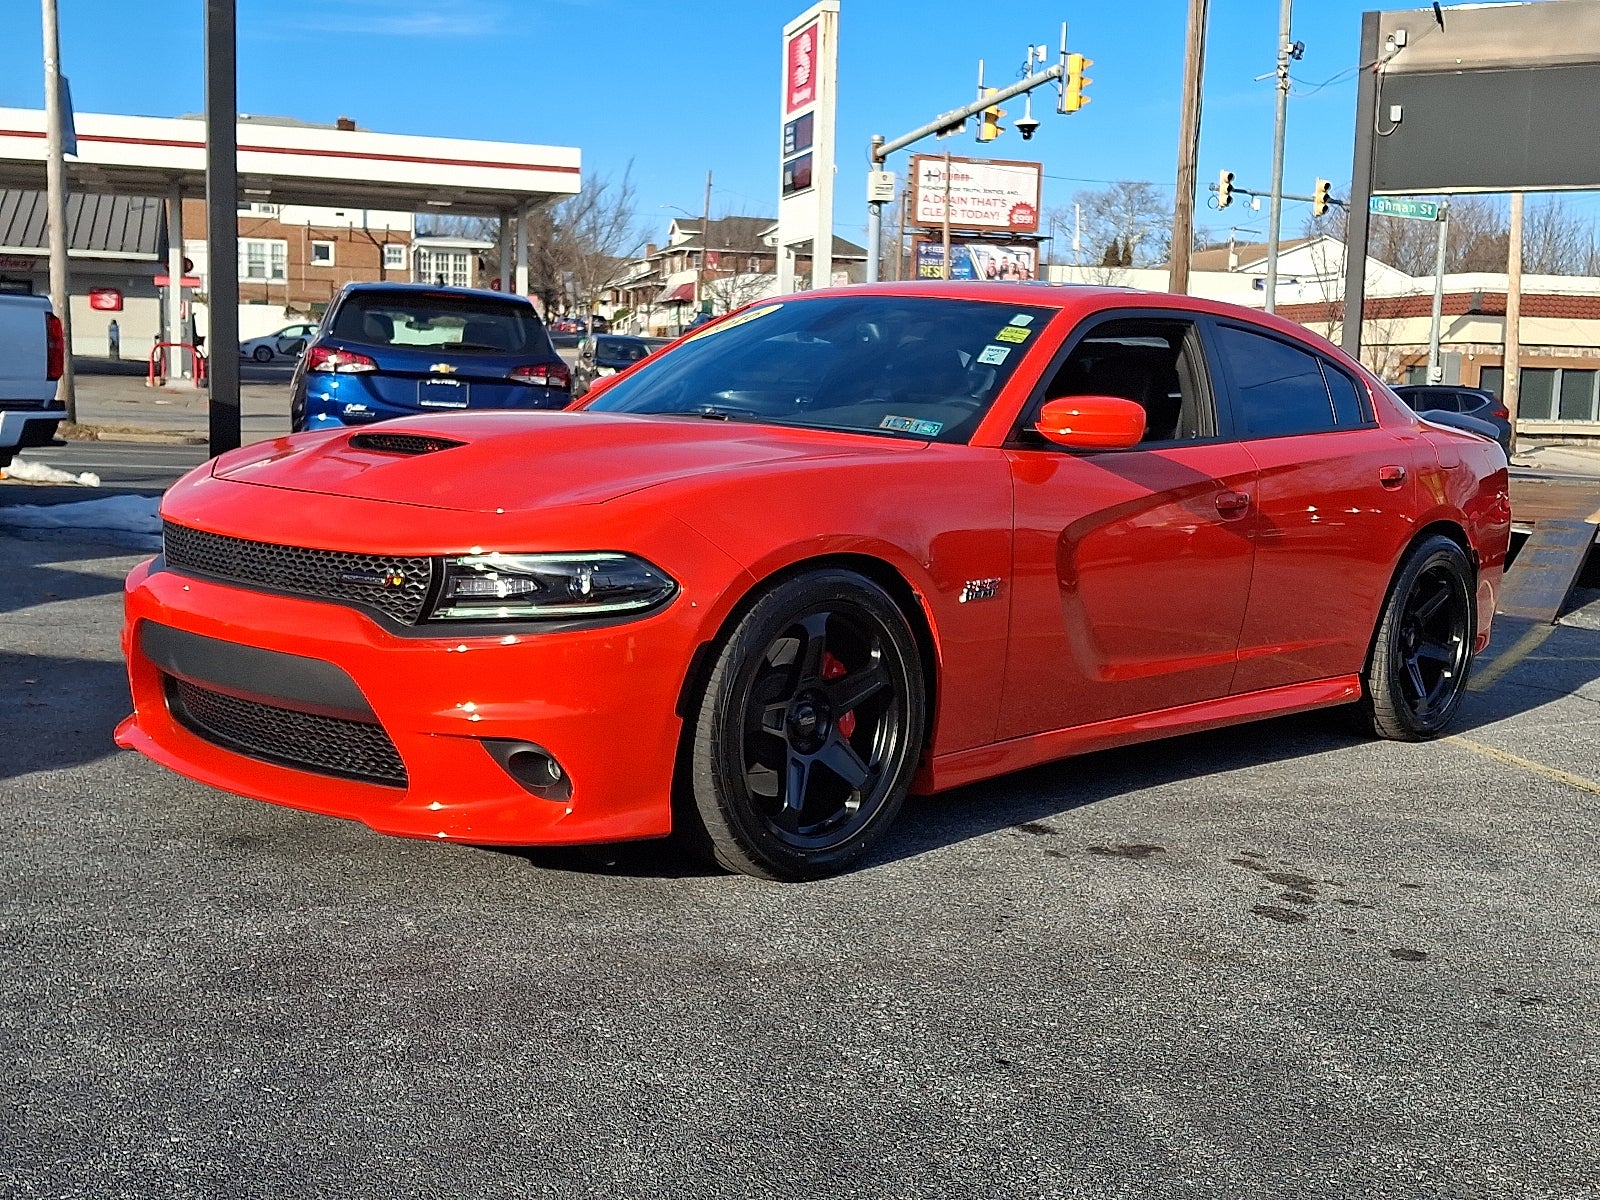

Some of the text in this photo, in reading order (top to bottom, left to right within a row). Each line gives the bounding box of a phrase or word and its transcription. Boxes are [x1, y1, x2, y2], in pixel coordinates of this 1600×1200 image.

[922, 194, 932, 203] A
[970, 197, 1007, 208] THAT'S
[922, 207, 1000, 220] CLER TODAY!
[1420, 204, 1433, 215] St
